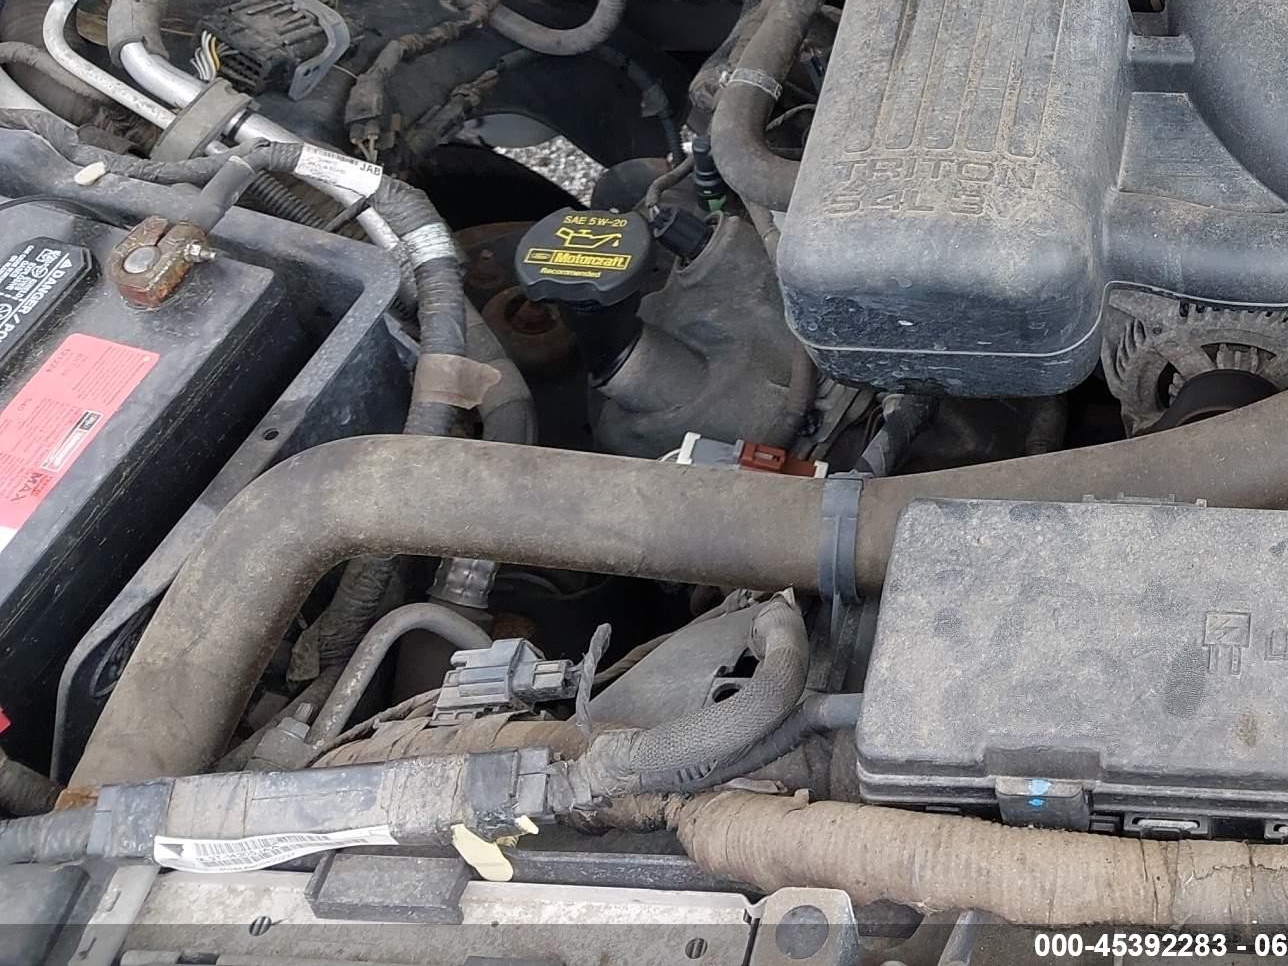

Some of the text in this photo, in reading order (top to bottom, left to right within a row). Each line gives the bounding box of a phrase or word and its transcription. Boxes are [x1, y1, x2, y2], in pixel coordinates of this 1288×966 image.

[360, 162, 381, 176] JAB
[833, 156, 1037, 189] TRITON
[563, 215, 628, 228] SAE 5W-20
[554, 252, 625, 268] Motorcraft
[18, 269, 66, 315] DANGER
[0, 323, 15, 343] PO
[10, 473, 44, 503] MAX
